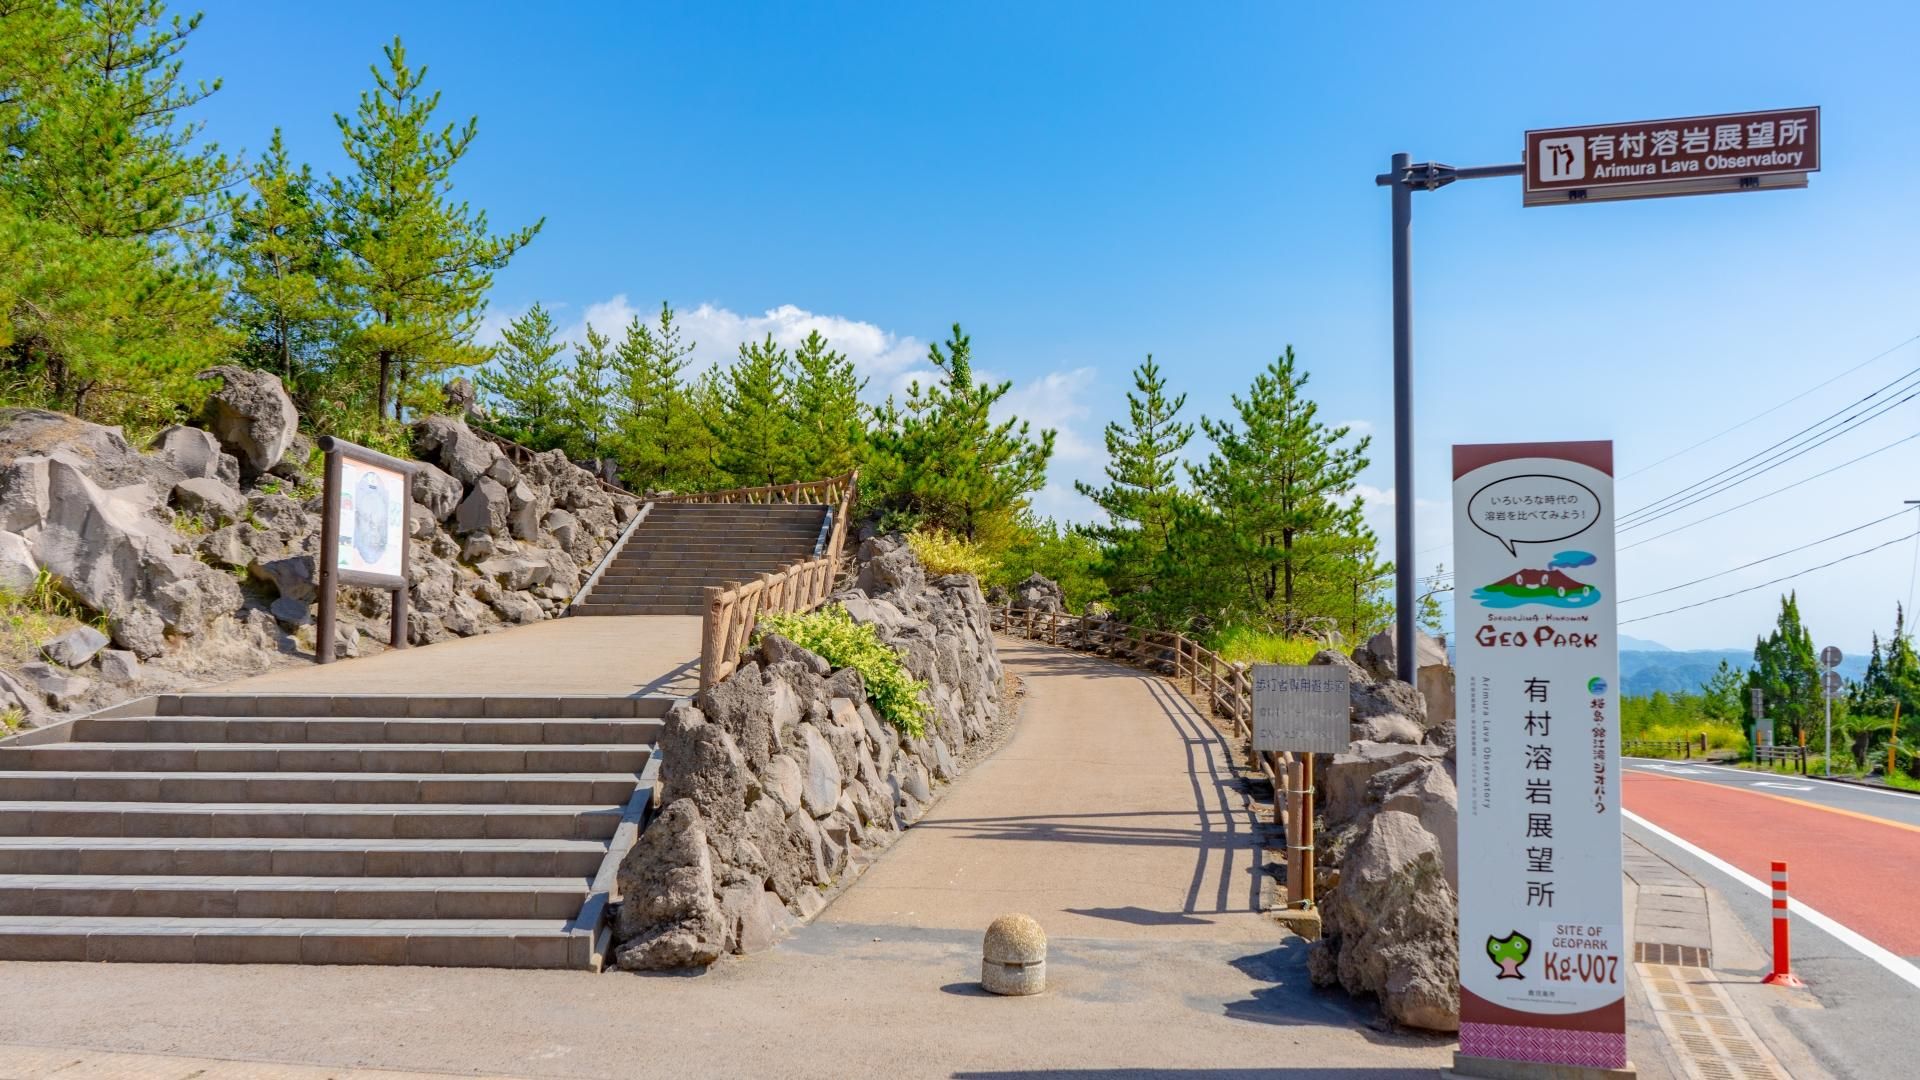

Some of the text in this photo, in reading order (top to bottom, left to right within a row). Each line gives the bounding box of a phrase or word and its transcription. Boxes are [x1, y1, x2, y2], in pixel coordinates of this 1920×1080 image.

[1587, 117, 1809, 161] 有村溶岩展望所
[1593, 150, 1804, 179] Arimura Lava Observatory
[1491, 495, 1578, 505] いろいろな時代の
[1475, 624, 1598, 648] GEO PARK
[1482, 676, 1492, 809] Arimura Lava Observatory
[1524, 676, 1555, 908] 有村溶岩展望所
[1552, 937, 1608, 950] GEOPARK
[1557, 924, 1603, 937] SITE OF
[1544, 951, 1619, 984] Kg-V07
